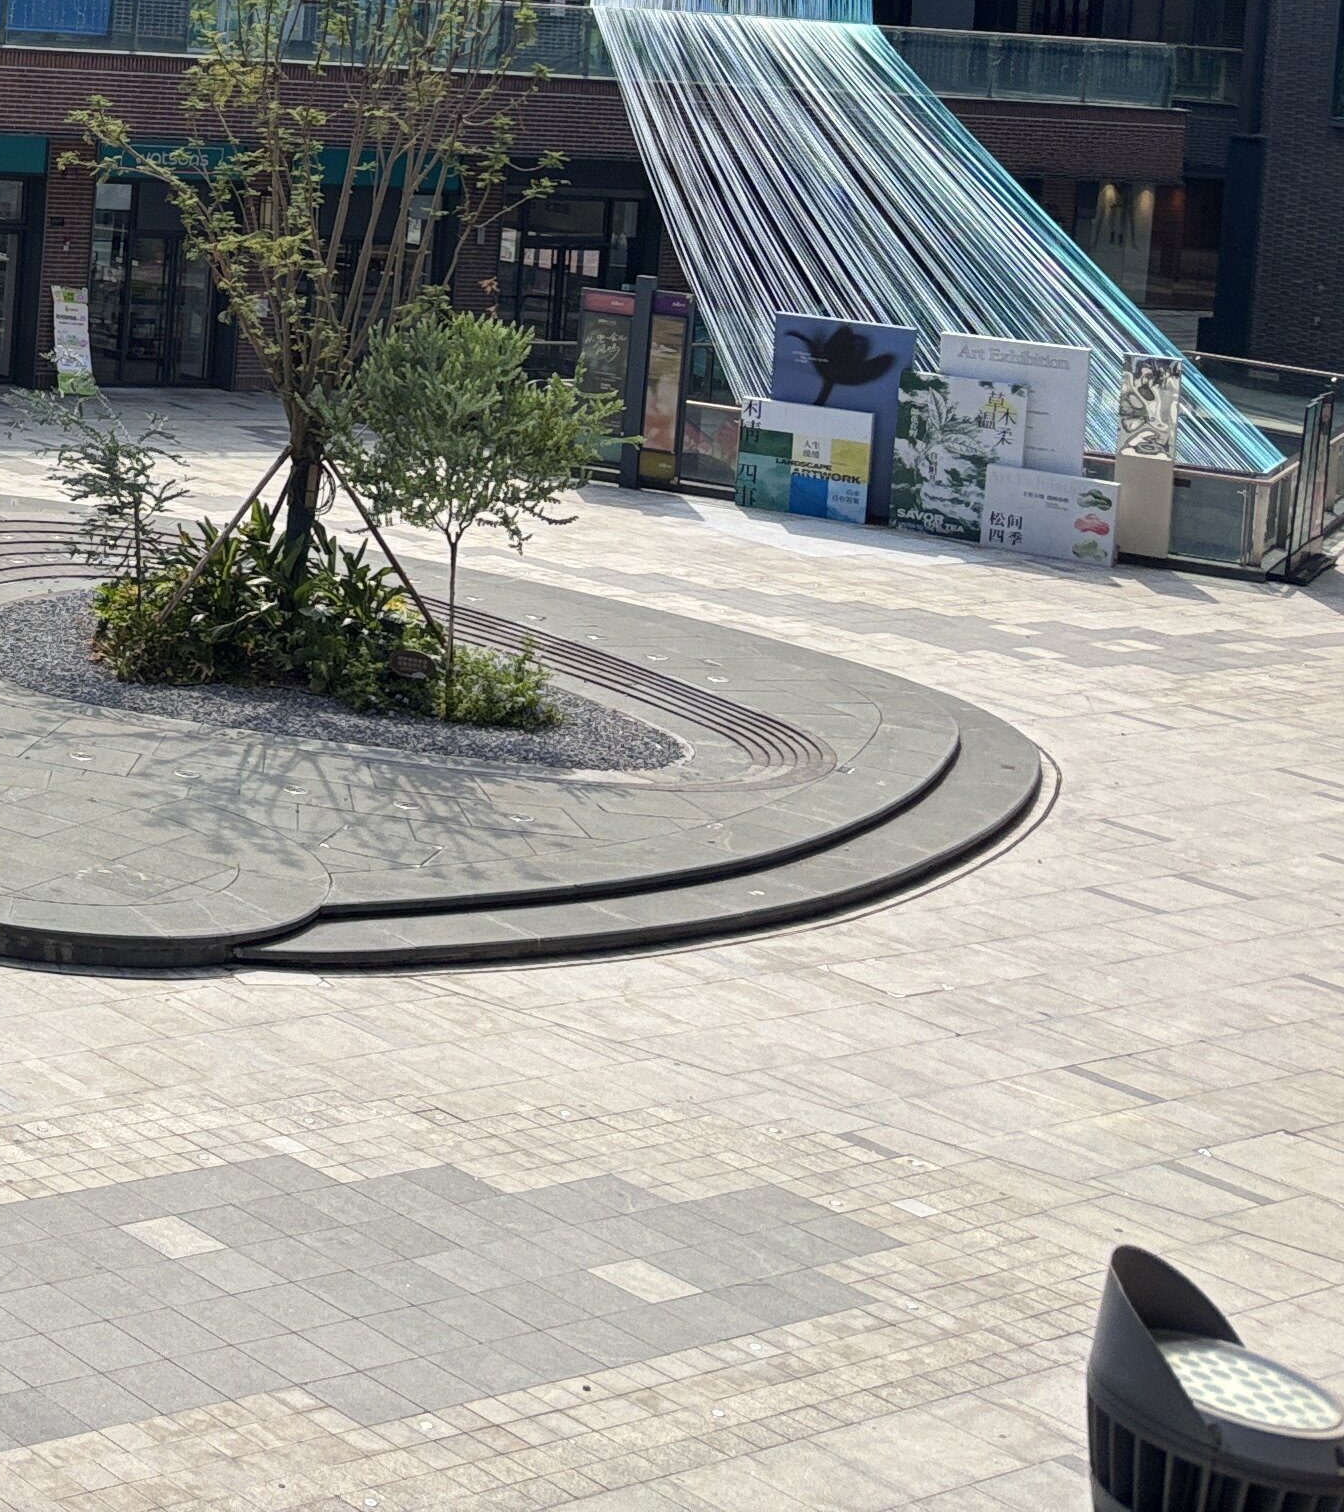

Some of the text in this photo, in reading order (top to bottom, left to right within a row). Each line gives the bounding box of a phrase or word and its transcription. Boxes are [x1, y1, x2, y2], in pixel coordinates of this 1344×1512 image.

[958, 344, 1071, 371] Art Exhibition
[775, 457, 832, 472] LANDSCAPE
[791, 467, 862, 485] ARTWORK
[989, 510, 1023, 530] 松间
[988, 528, 1023, 546] 四季
